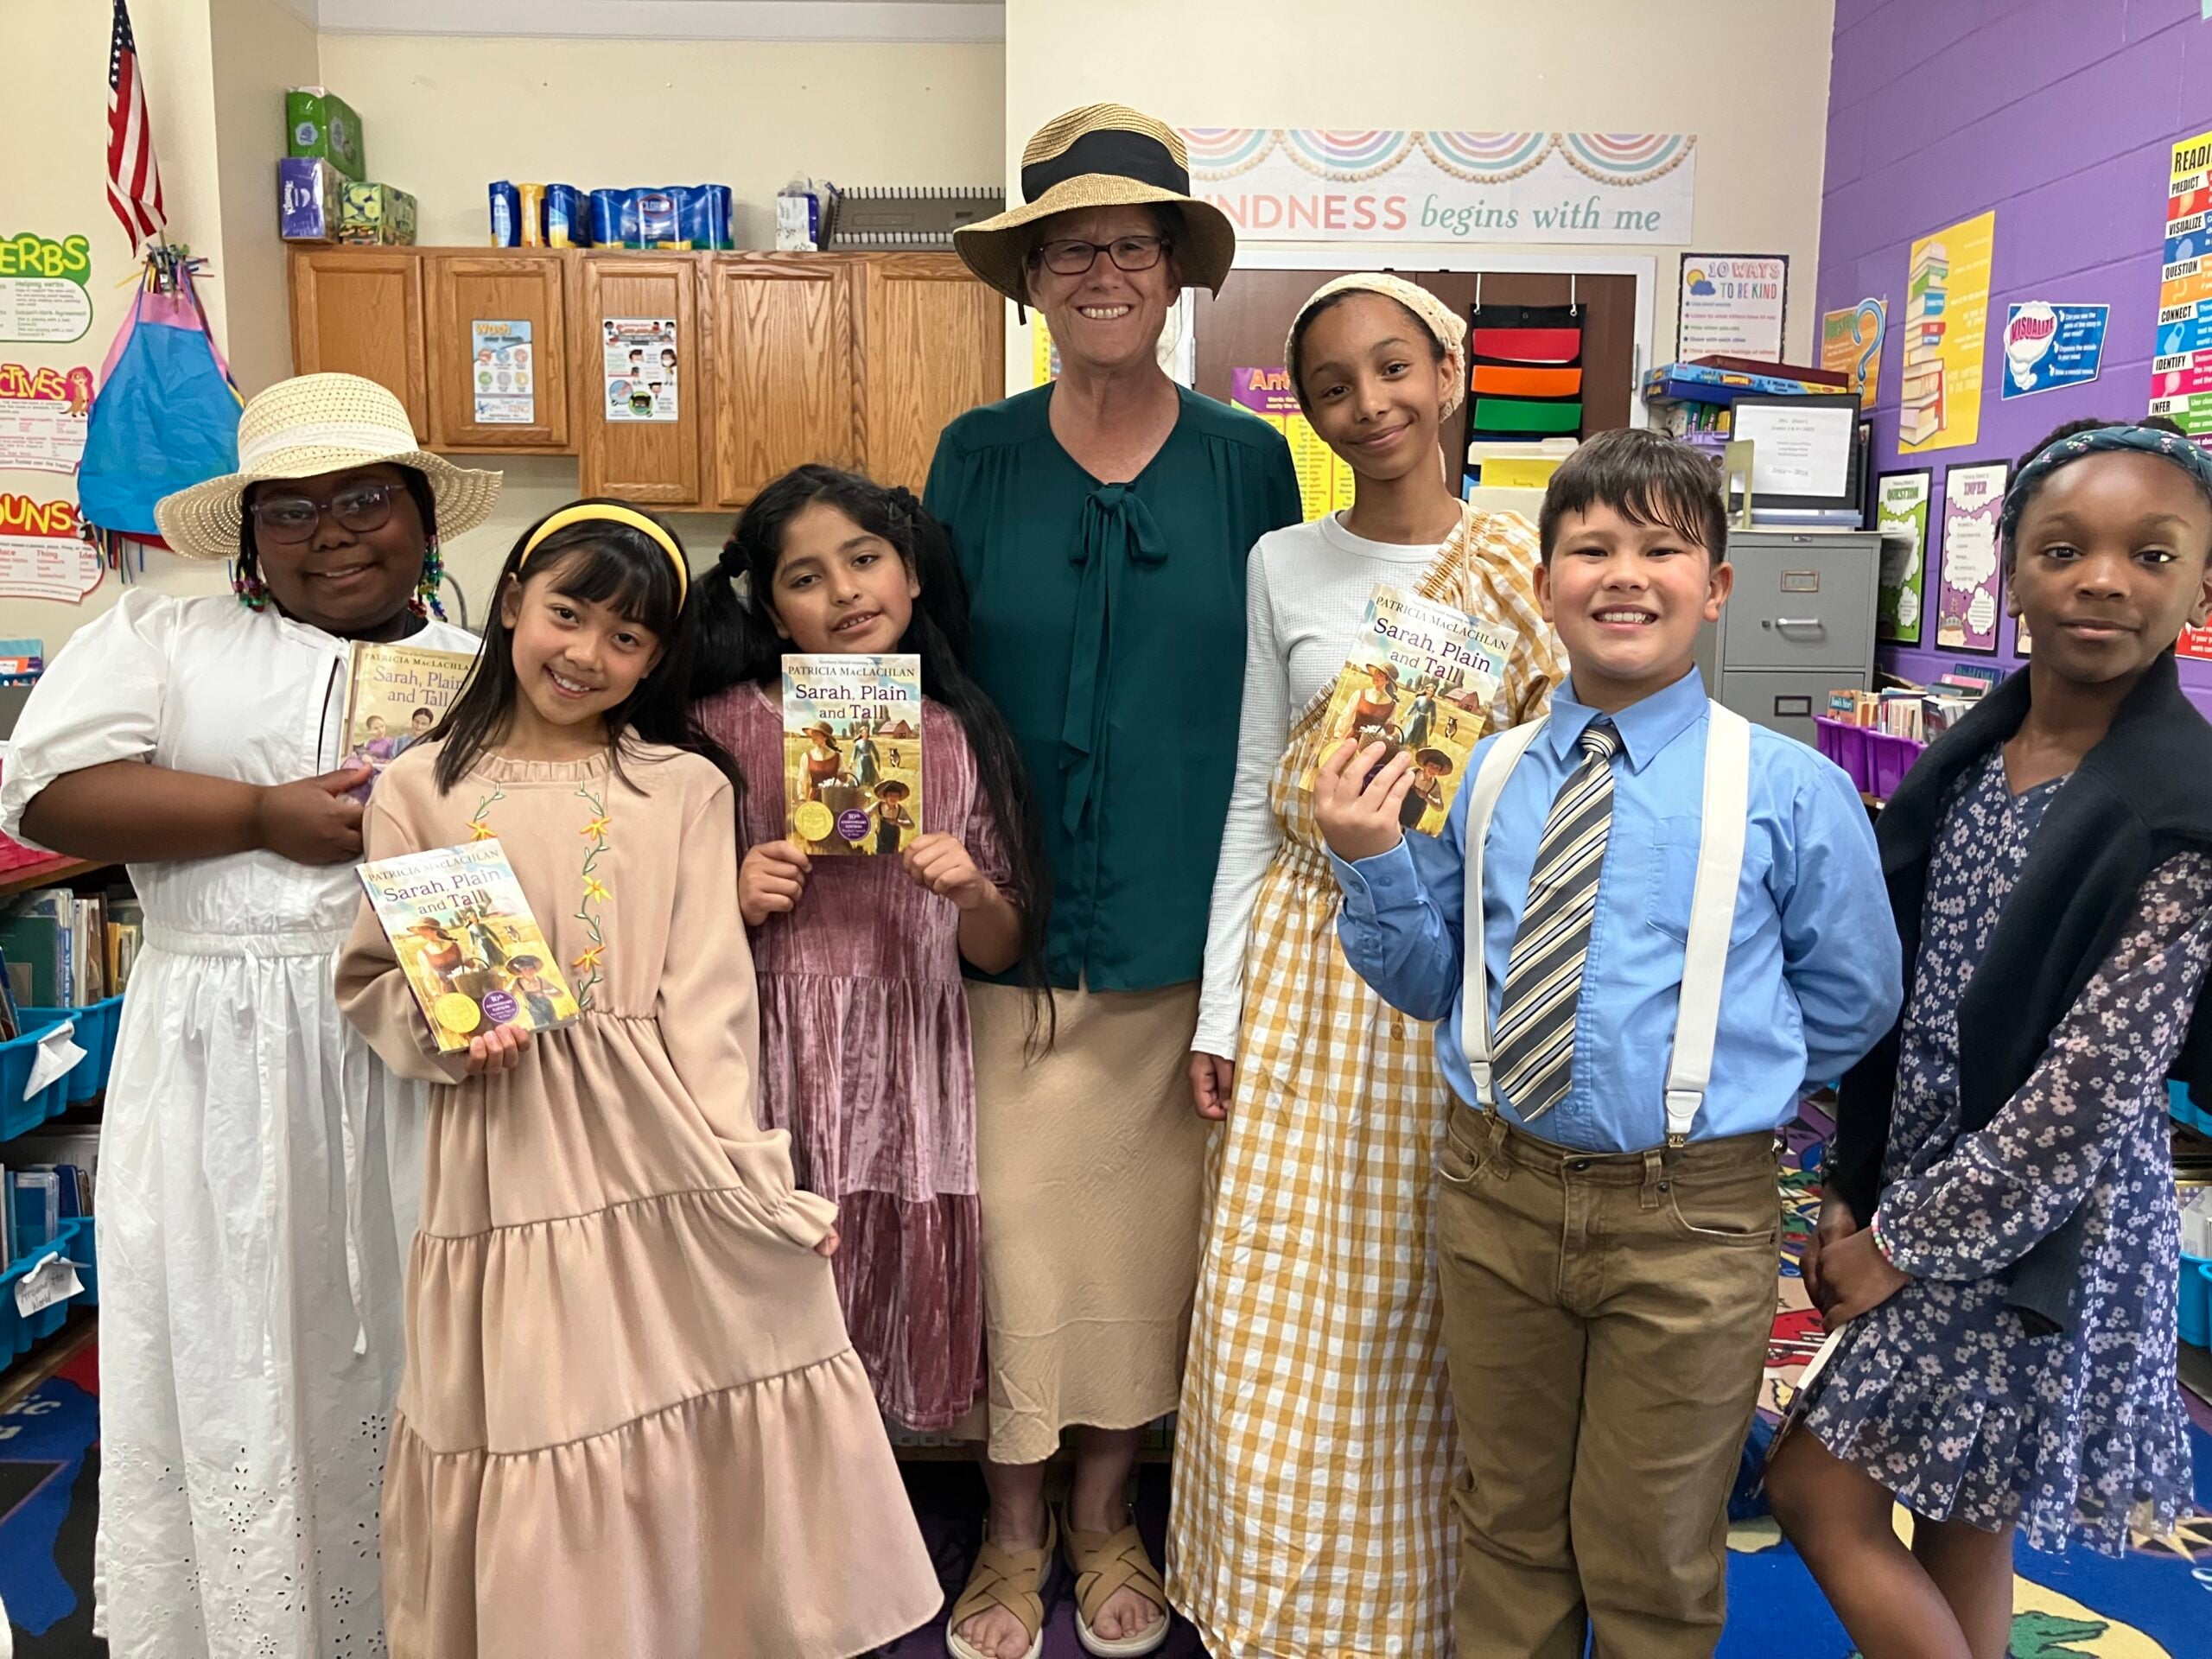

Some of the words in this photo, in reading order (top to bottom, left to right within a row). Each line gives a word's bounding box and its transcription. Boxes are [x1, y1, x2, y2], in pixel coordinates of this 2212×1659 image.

[2174, 143, 2212, 173] READI
[2171, 175, 2200, 194] PREDICT
[1194, 194, 1407, 231] NDNESS
[1421, 194, 1519, 236] begins
[1533, 195, 1601, 229] with
[1614, 208, 1661, 232] me
[2169, 215, 2202, 235] VISUALIZE
[1708, 261, 1729, 277] 10
[1732, 262, 1780, 279] WAYS
[2165, 260, 2197, 279] QUESTION
[1720, 283, 1733, 298] TO
[1738, 283, 1749, 299] BE
[1751, 283, 1777, 299] KIND
[2161, 305, 2192, 322] CONNECT
[2010, 316, 2055, 344] VISUALIZE
[2155, 355, 2186, 371] IDENTIFY
[0, 365, 67, 400] CTIVES
[2152, 401, 2171, 414] INFER
[1887, 486, 1919, 501] QUESTION
[1964, 481, 1986, 495] INFER
[37, 550, 58, 559] Thing
[1376, 596, 1426, 622] PATRICIA
[1373, 618, 1435, 653] Sarah,
[1440, 641, 1491, 673] Plain
[365, 653, 410, 664] PATRICIA
[1390, 651, 1420, 669] and
[1424, 657, 1459, 683] Tall
[374, 665, 423, 688] Sarah,
[788, 666, 836, 676] PATRICIA
[387, 689, 415, 703] and
[420, 690, 448, 707] Tall
[796, 684, 855, 701] Sarah,
[861, 685, 907, 701] Plain
[819, 708, 845, 719] and
[849, 704, 883, 720] Tall
[368, 866, 421, 881] PATRICIA
[384, 881, 449, 902] Sarah,
[451, 869, 501, 889] Plain
[418, 901, 447, 915] and
[447, 889, 484, 908] Tall
